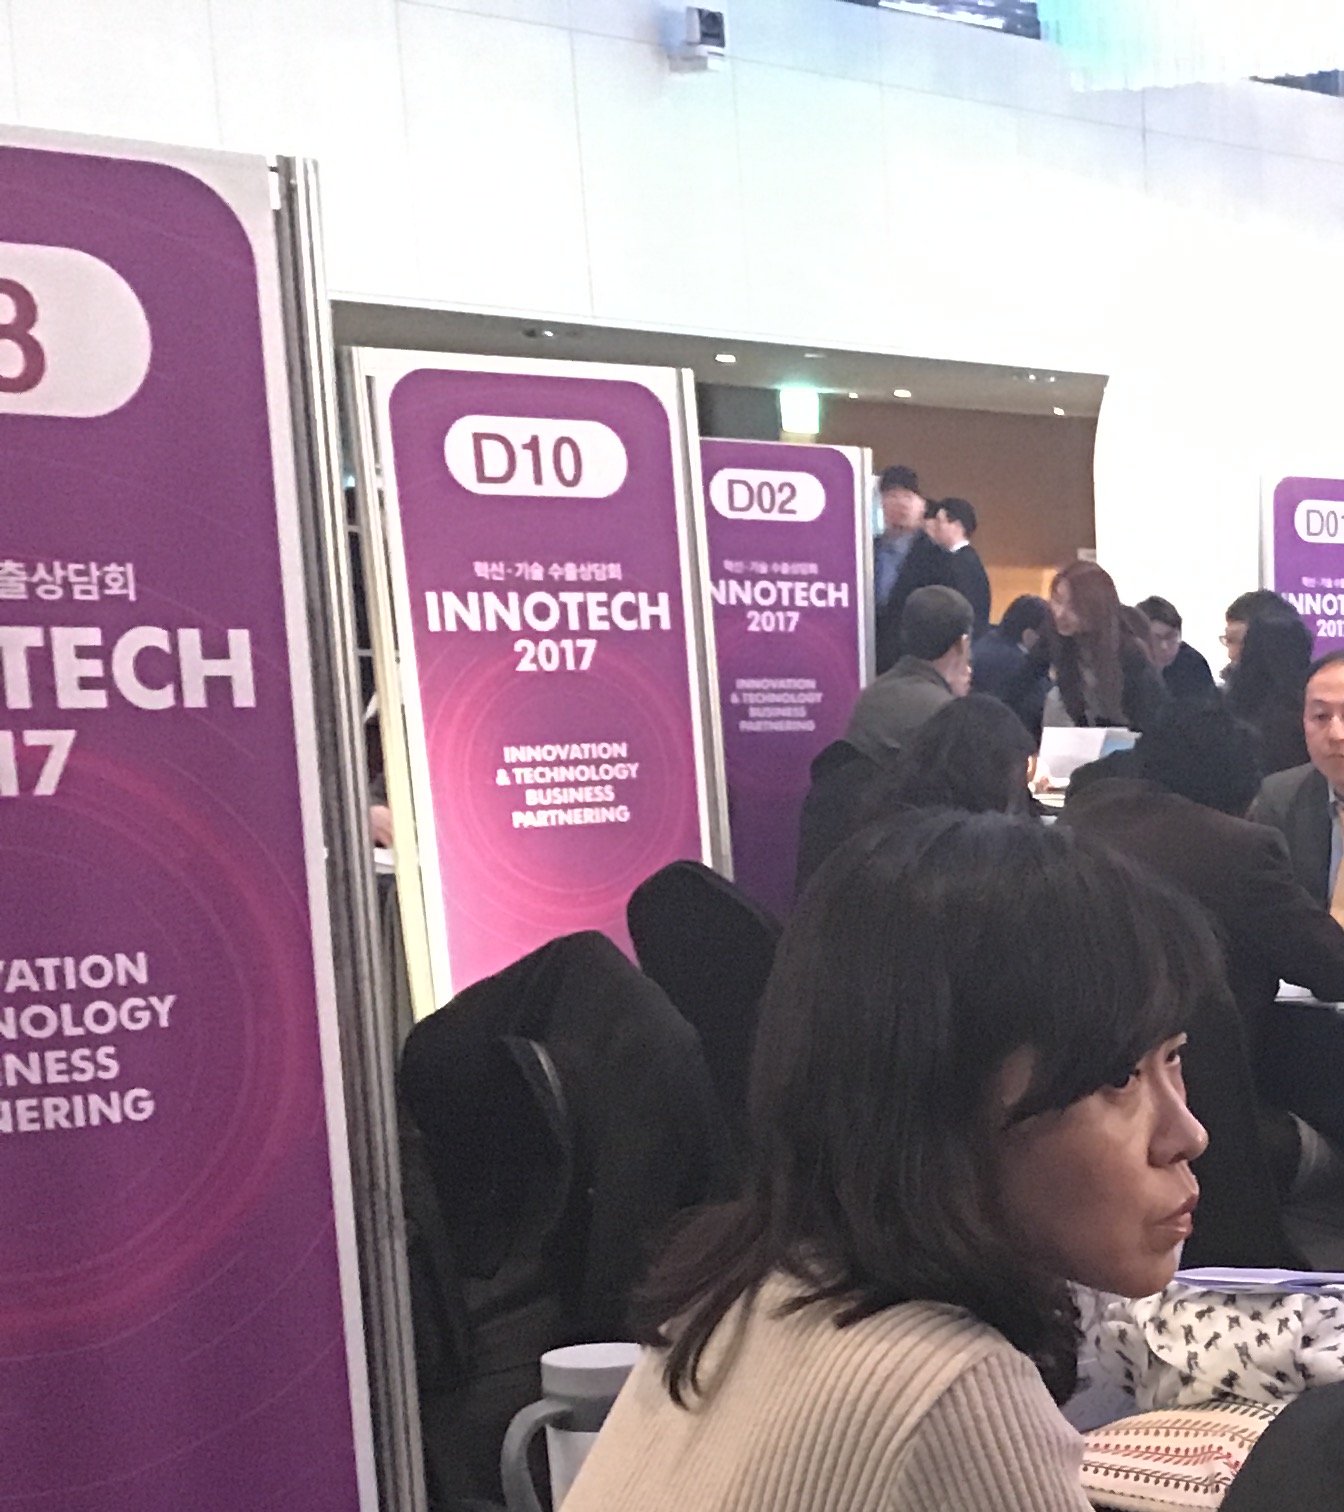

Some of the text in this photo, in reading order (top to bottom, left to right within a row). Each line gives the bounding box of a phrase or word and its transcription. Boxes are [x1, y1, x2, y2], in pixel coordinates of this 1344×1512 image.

[472, 432, 583, 488] D10
[728, 479, 798, 515] D02
[0, 559, 136, 601] 출상담회
[710, 579, 849, 608] NNOTECH
[424, 591, 672, 632] INNOTECH
[747, 610, 800, 632] 2017
[0, 625, 257, 711] TECH
[513, 638, 597, 672] 2017
[0, 729, 77, 796] 17
[503, 742, 628, 763] INNOVATION
[495, 762, 639, 786] & TECHNOLOGY
[525, 784, 615, 806] BUSINESS
[511, 805, 631, 829] PARTNERING
[0, 951, 149, 994] ATION
[0, 994, 178, 1040] NOLOGY
[0, 1045, 120, 1087] NESS
[0, 1087, 155, 1134] ERING
